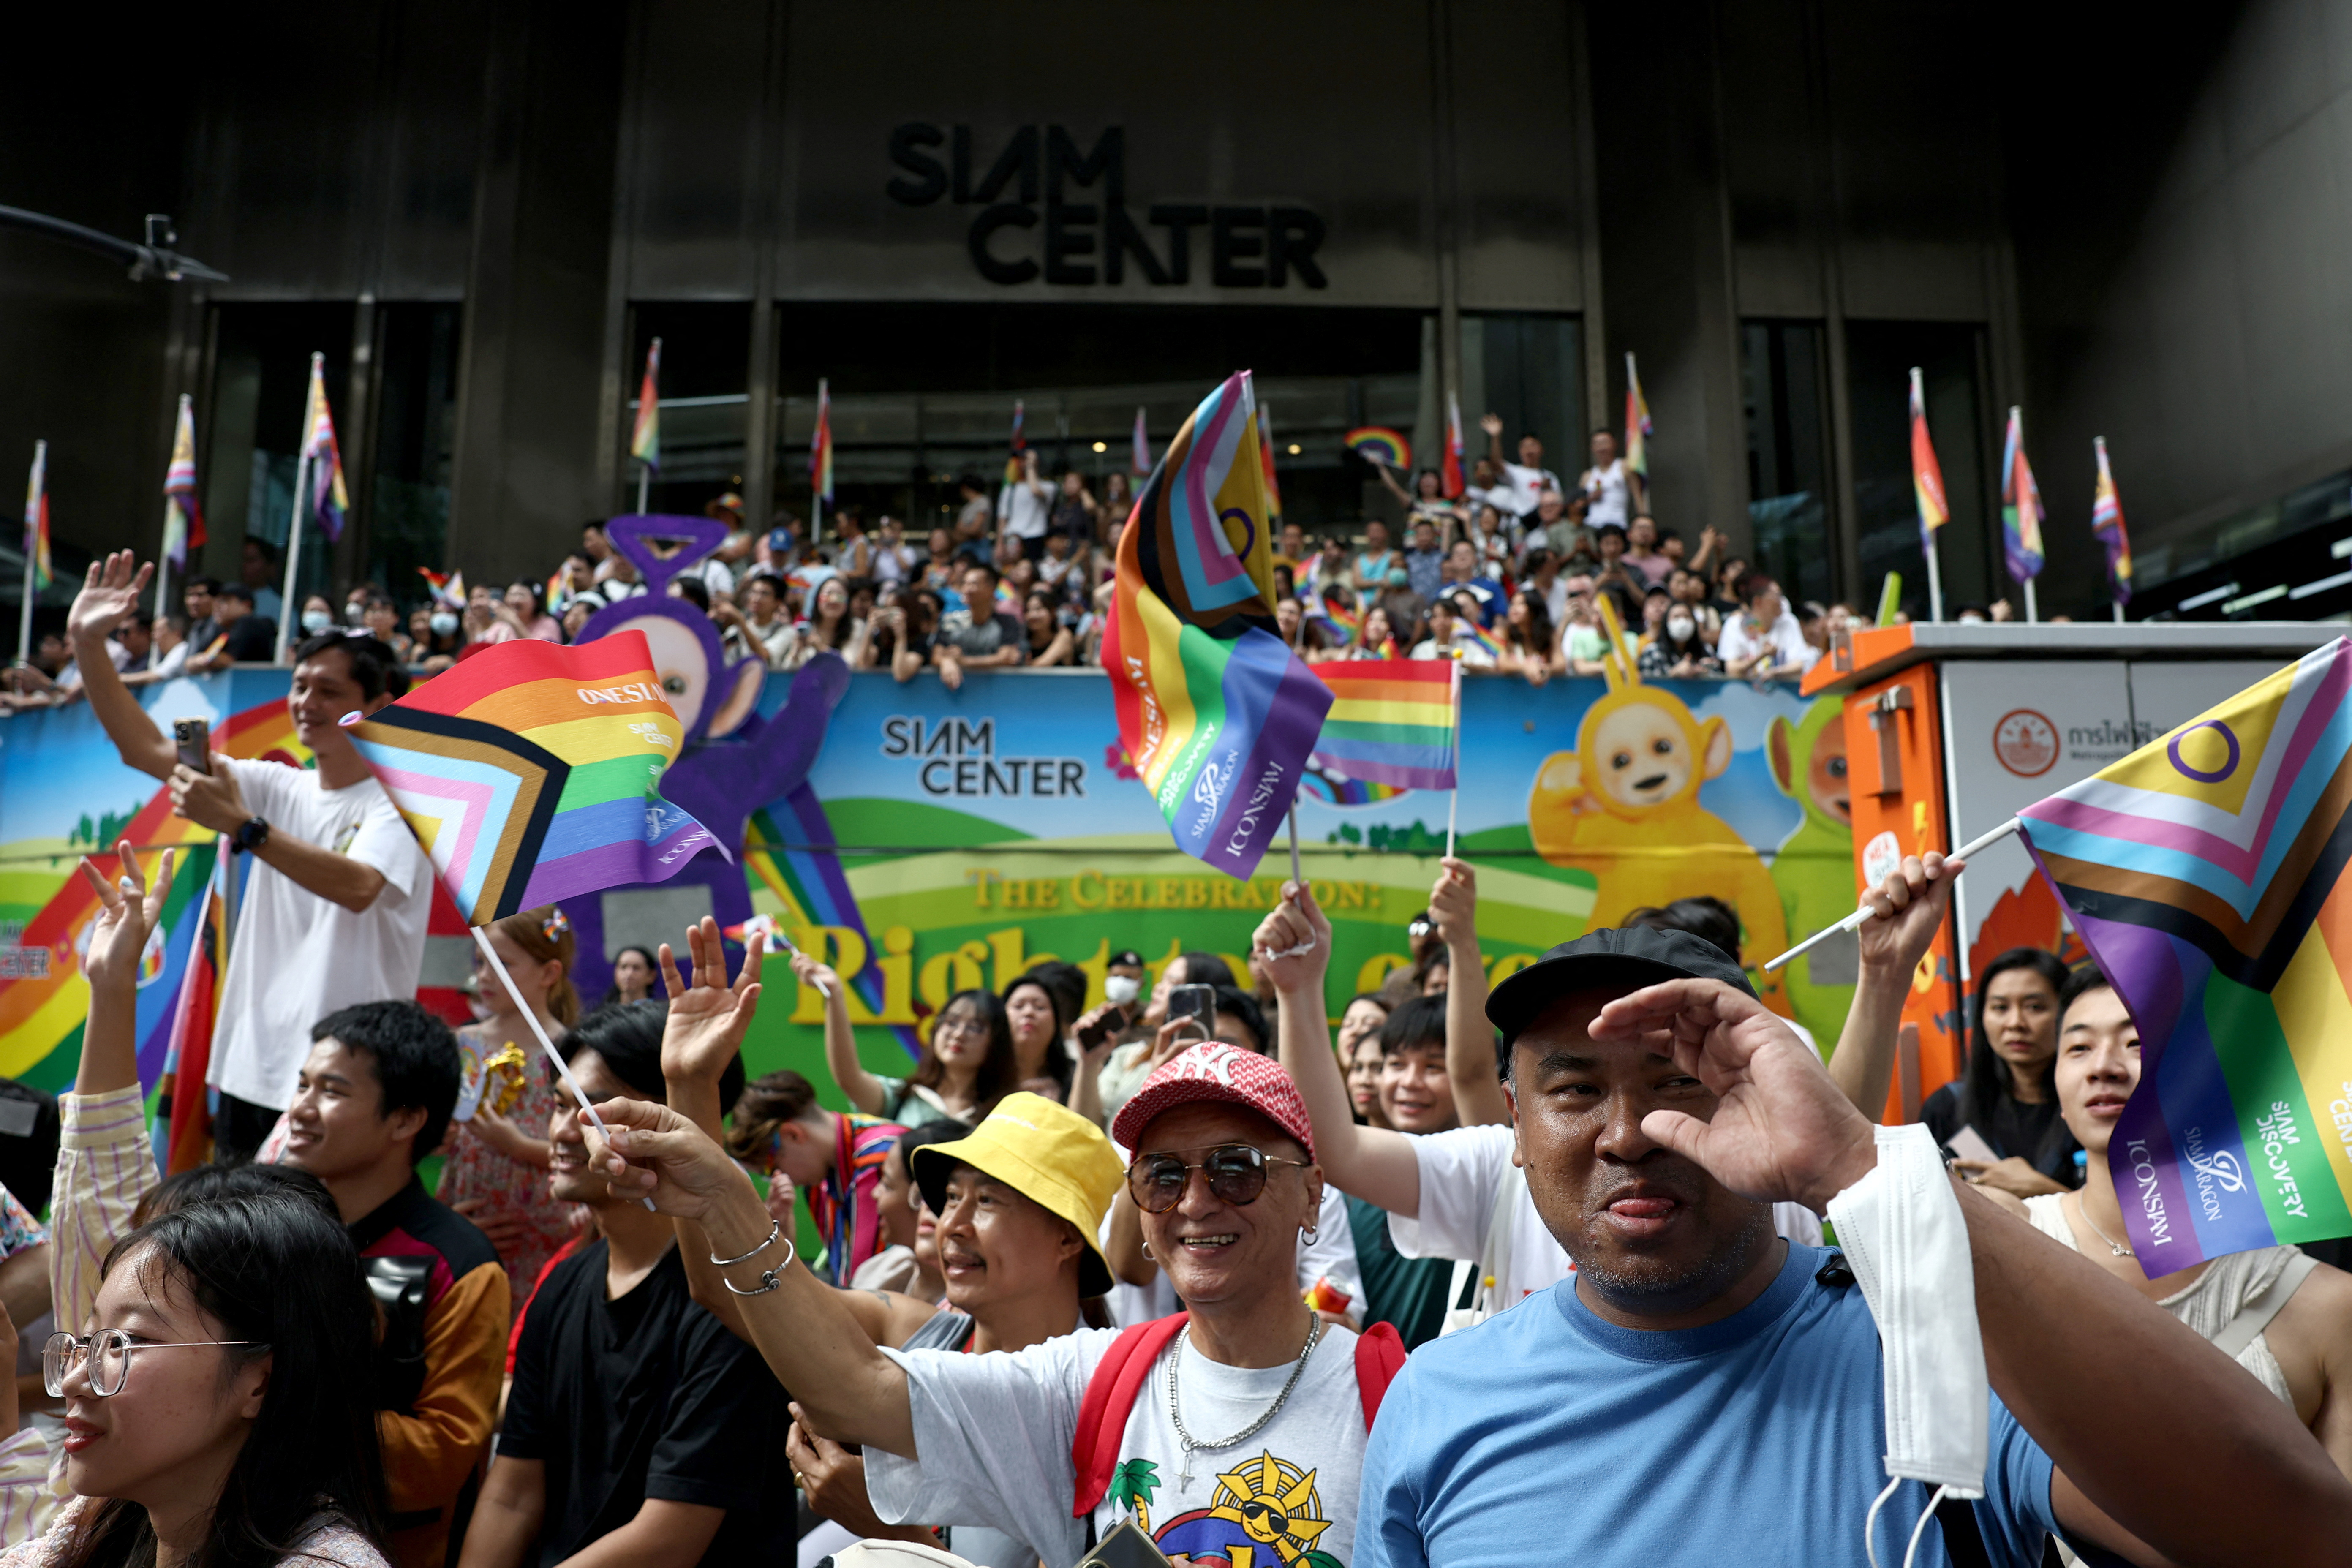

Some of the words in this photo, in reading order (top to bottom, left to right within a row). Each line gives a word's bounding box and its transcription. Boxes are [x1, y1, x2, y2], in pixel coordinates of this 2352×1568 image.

[886, 122, 1125, 206] SIAM
[967, 203, 1328, 289] CENTER
[885, 720, 991, 756] SIAM
[922, 760, 1085, 795] CENTER
[1226, 760, 1284, 857] ICONSIAM
[1070, 868, 1381, 909] CELEBRATON:
[2272, 1101, 2301, 1145] SIAM
[2126, 1139, 2172, 1247] ICONSIAM
[2256, 1114, 2308, 1218] DISCOVERY
